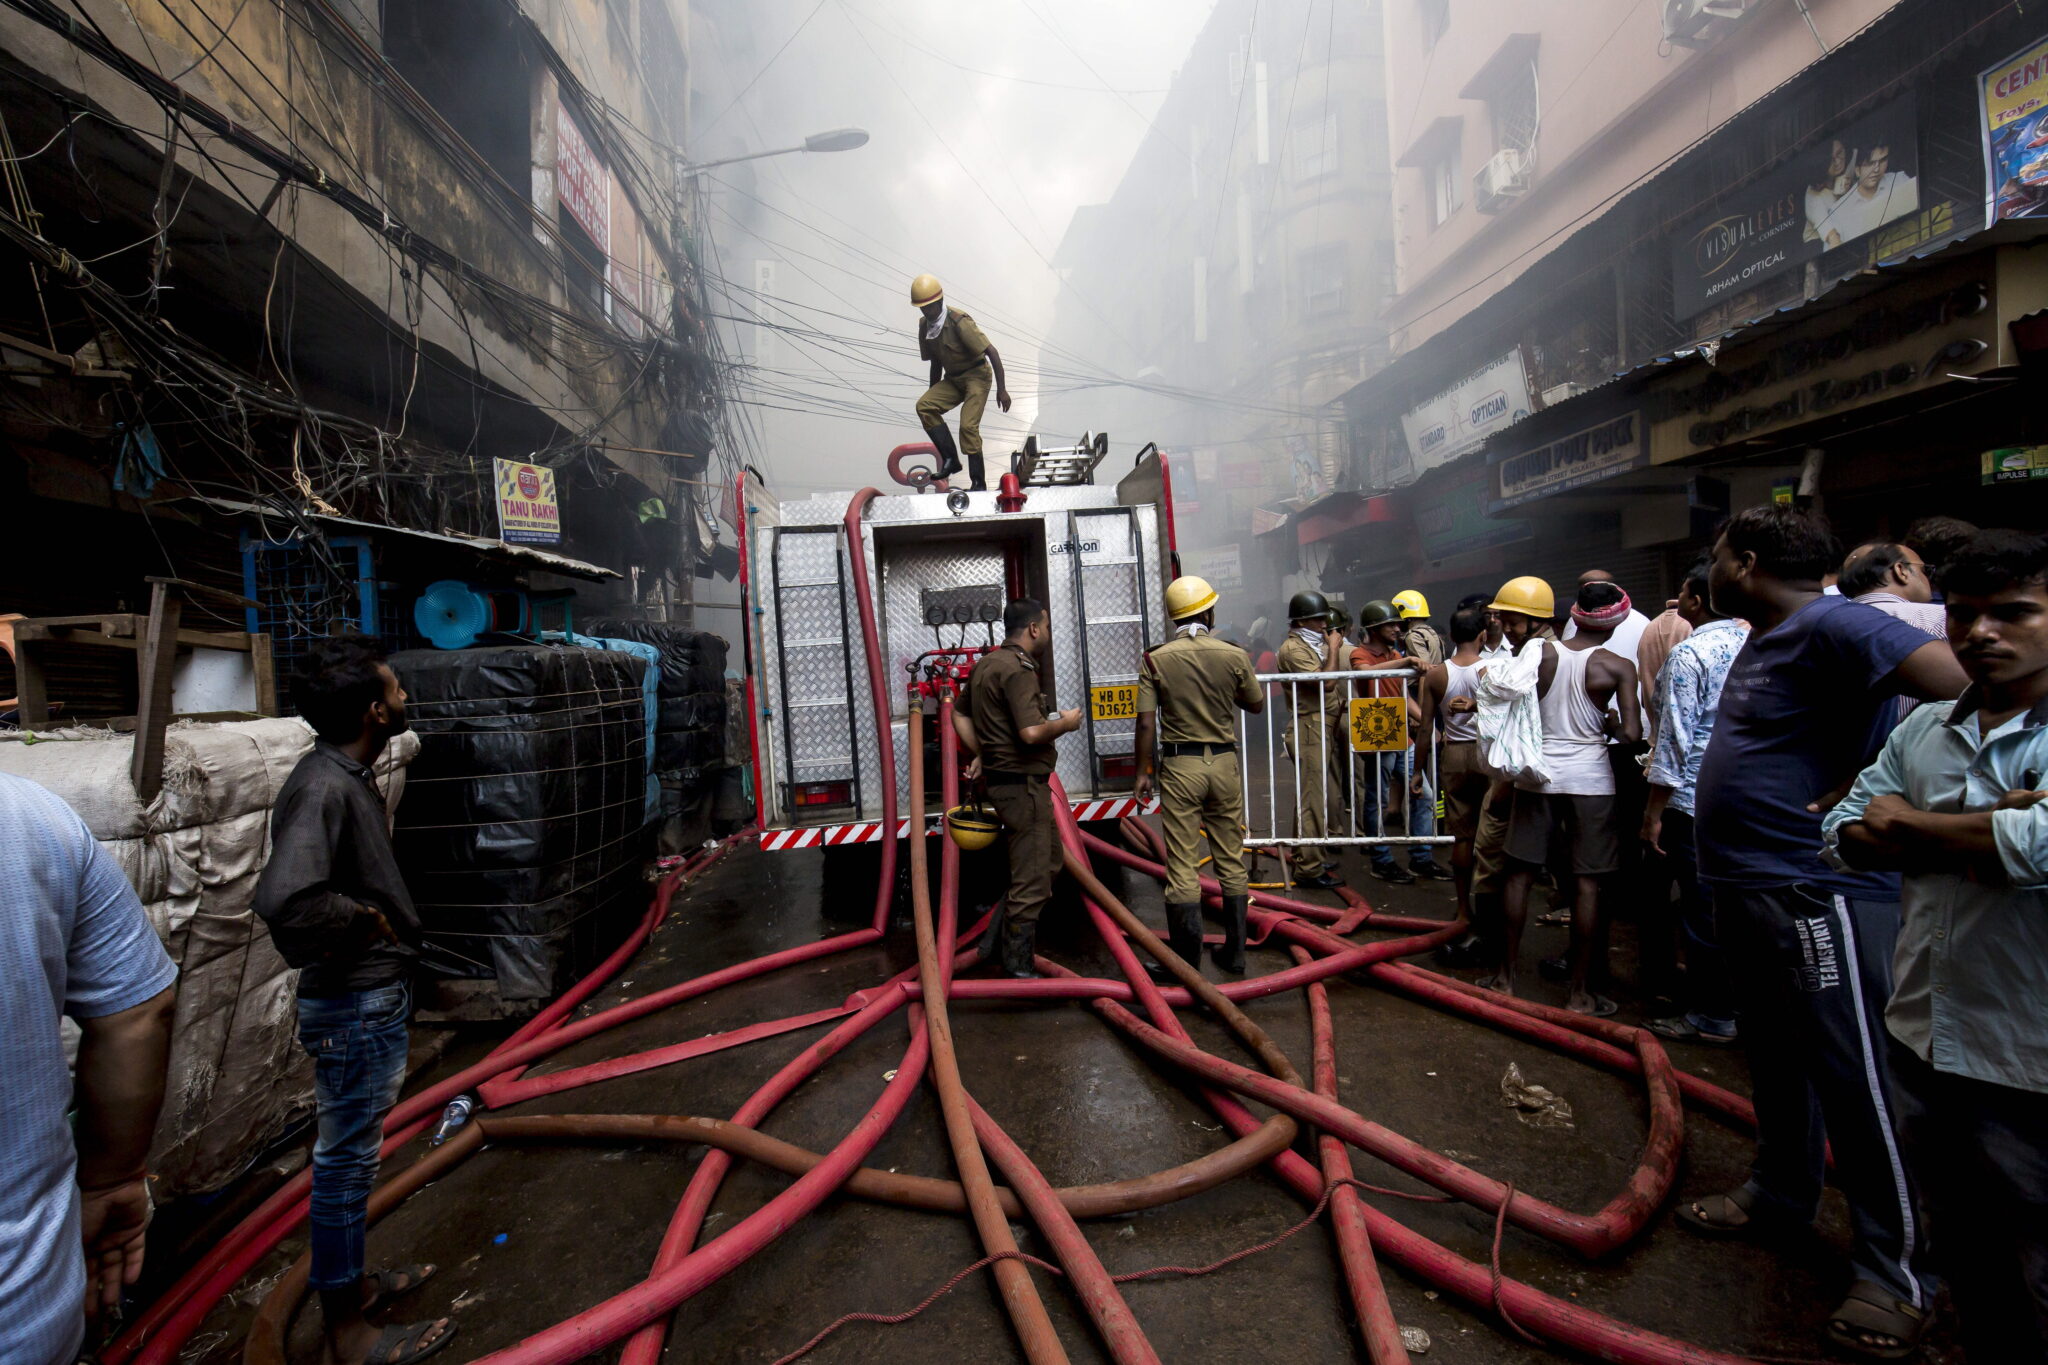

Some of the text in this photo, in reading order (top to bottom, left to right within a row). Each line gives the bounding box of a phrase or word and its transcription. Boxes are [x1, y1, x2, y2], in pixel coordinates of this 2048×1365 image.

[558, 136, 582, 188] SPORT
[1705, 250, 1786, 298] ARHAM OPTICAL
[1470, 354, 1510, 381] COMPUTER
[1420, 426, 1446, 449] STANDARD
[1471, 395, 1507, 425] OPTICIAN
[1996, 470, 2029, 481] IMPULSE
[502, 499, 558, 520] TANU RAKHI
[1098, 701, 1135, 717] D3623
[1099, 689, 1132, 702] WB 03
[1807, 917, 1841, 989] TEAMSPIRIT
